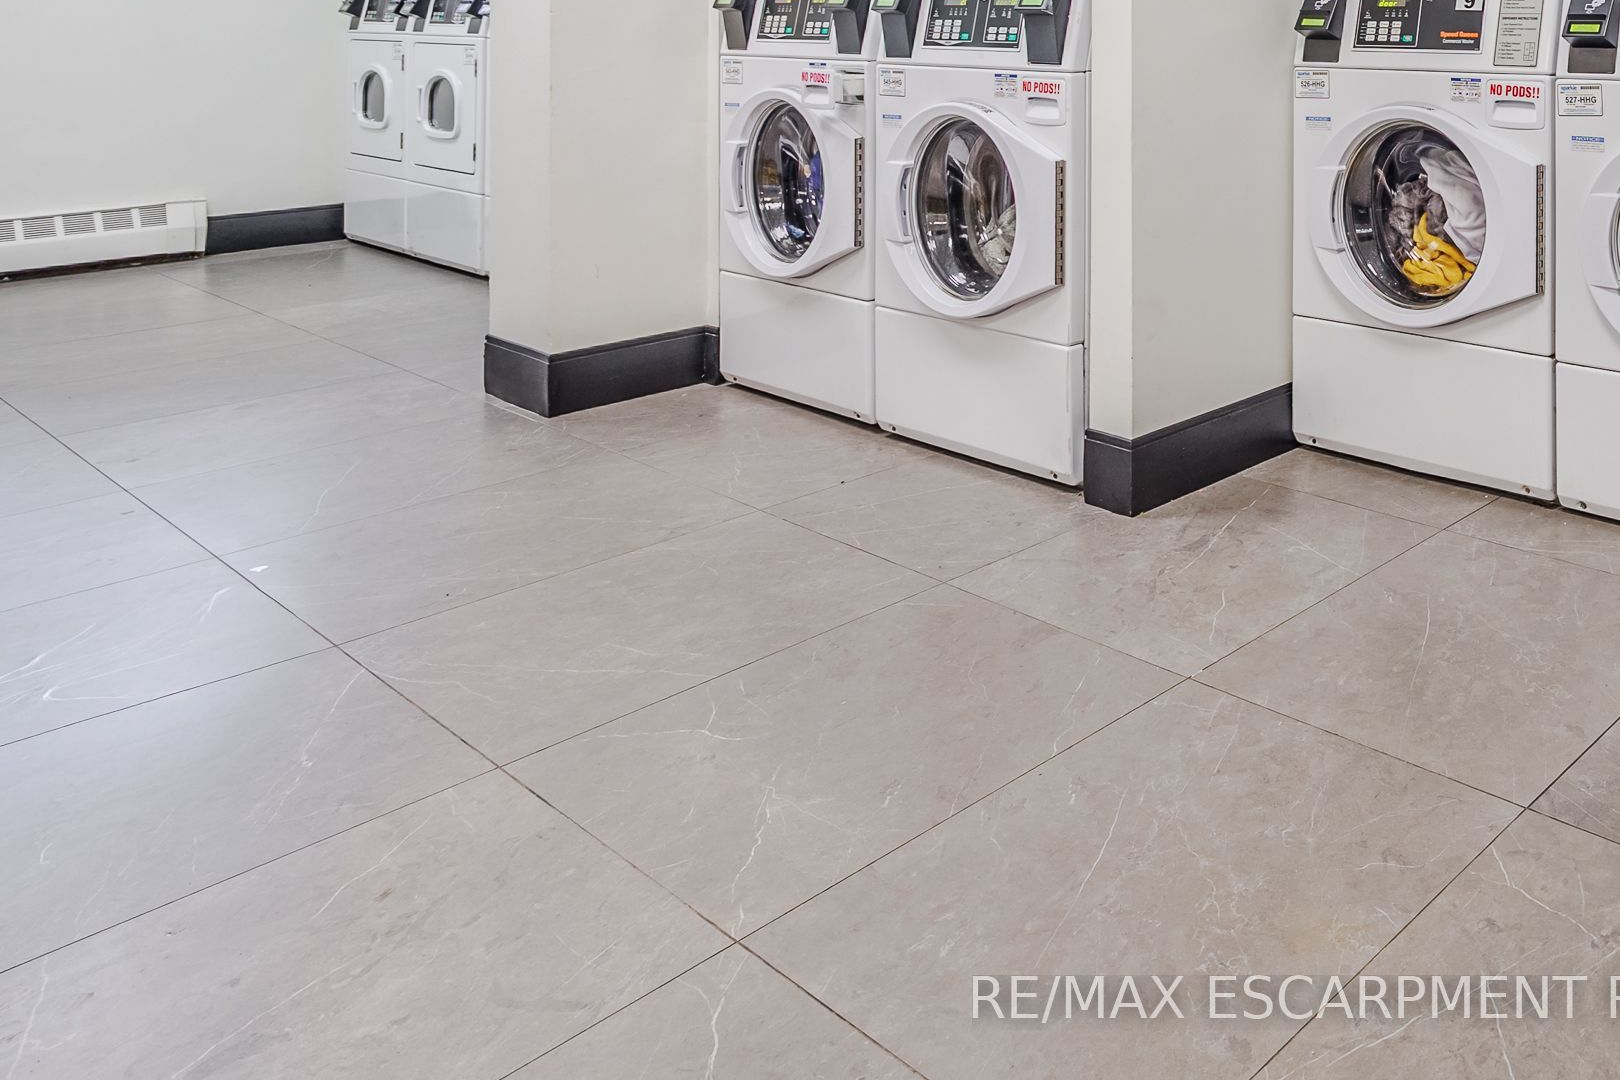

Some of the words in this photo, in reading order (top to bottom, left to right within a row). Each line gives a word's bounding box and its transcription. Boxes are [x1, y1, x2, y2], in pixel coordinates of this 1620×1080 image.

[1379, 0, 1398, 7] door
[801, 72, 809, 82] NO
[810, 72, 830, 84] PODS!!
[1022, 81, 1032, 92] NO
[1034, 81, 1060, 94] PODS!!
[1300, 80, 1326, 88] 526-HHG
[1490, 84, 1502, 96] NO
[1505, 85, 1540, 99] PODS!!
[1565, 96, 1597, 104] 527-HHG
